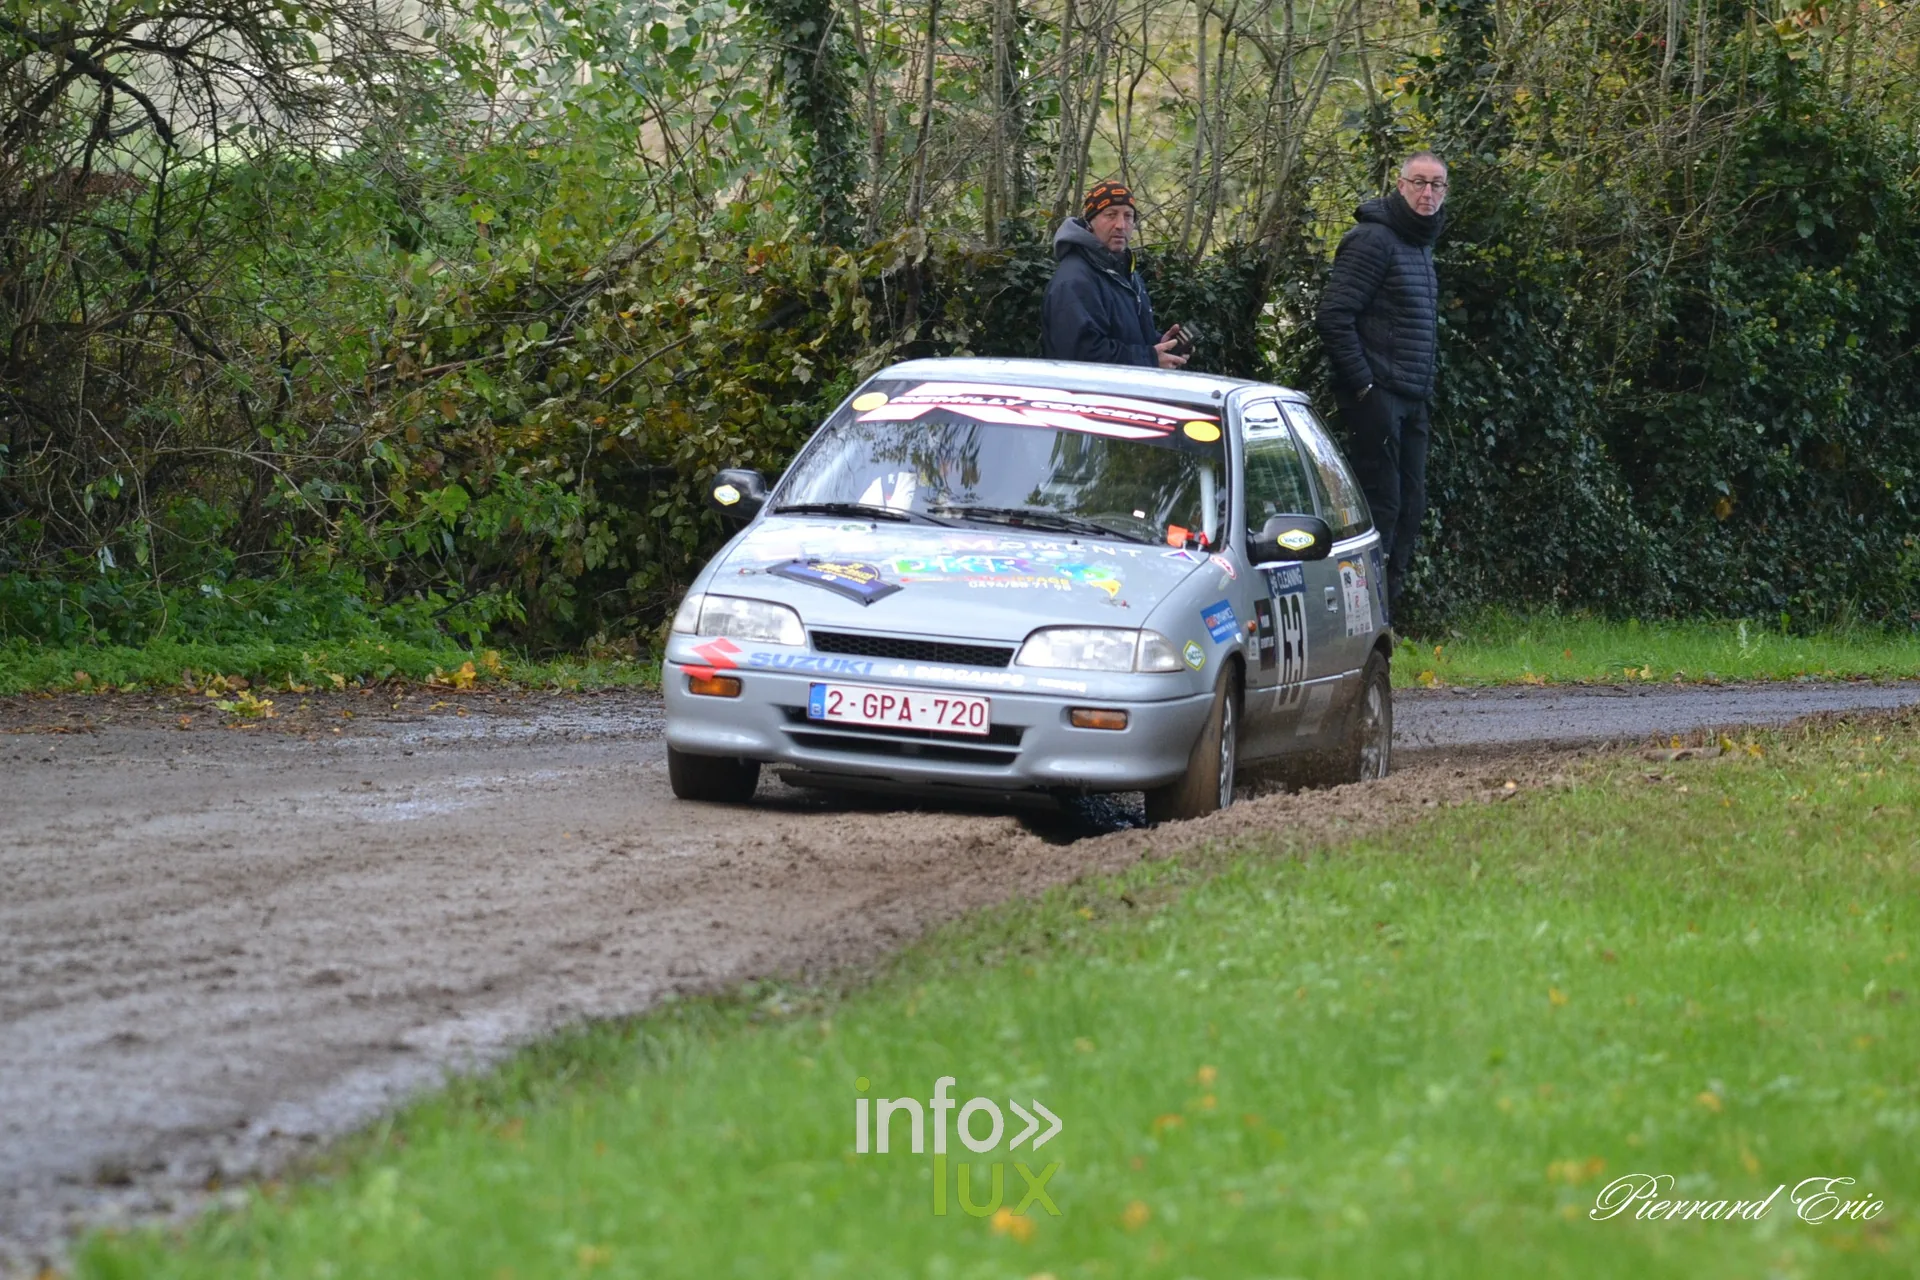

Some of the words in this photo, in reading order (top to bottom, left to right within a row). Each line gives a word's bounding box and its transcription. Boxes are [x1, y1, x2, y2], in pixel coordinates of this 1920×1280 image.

[1030, 401, 1178, 426] CONCEPT
[1277, 568, 1303, 589] CLEANING
[748, 652, 875, 675] SUZUKI
[811, 703, 821, 715] B
